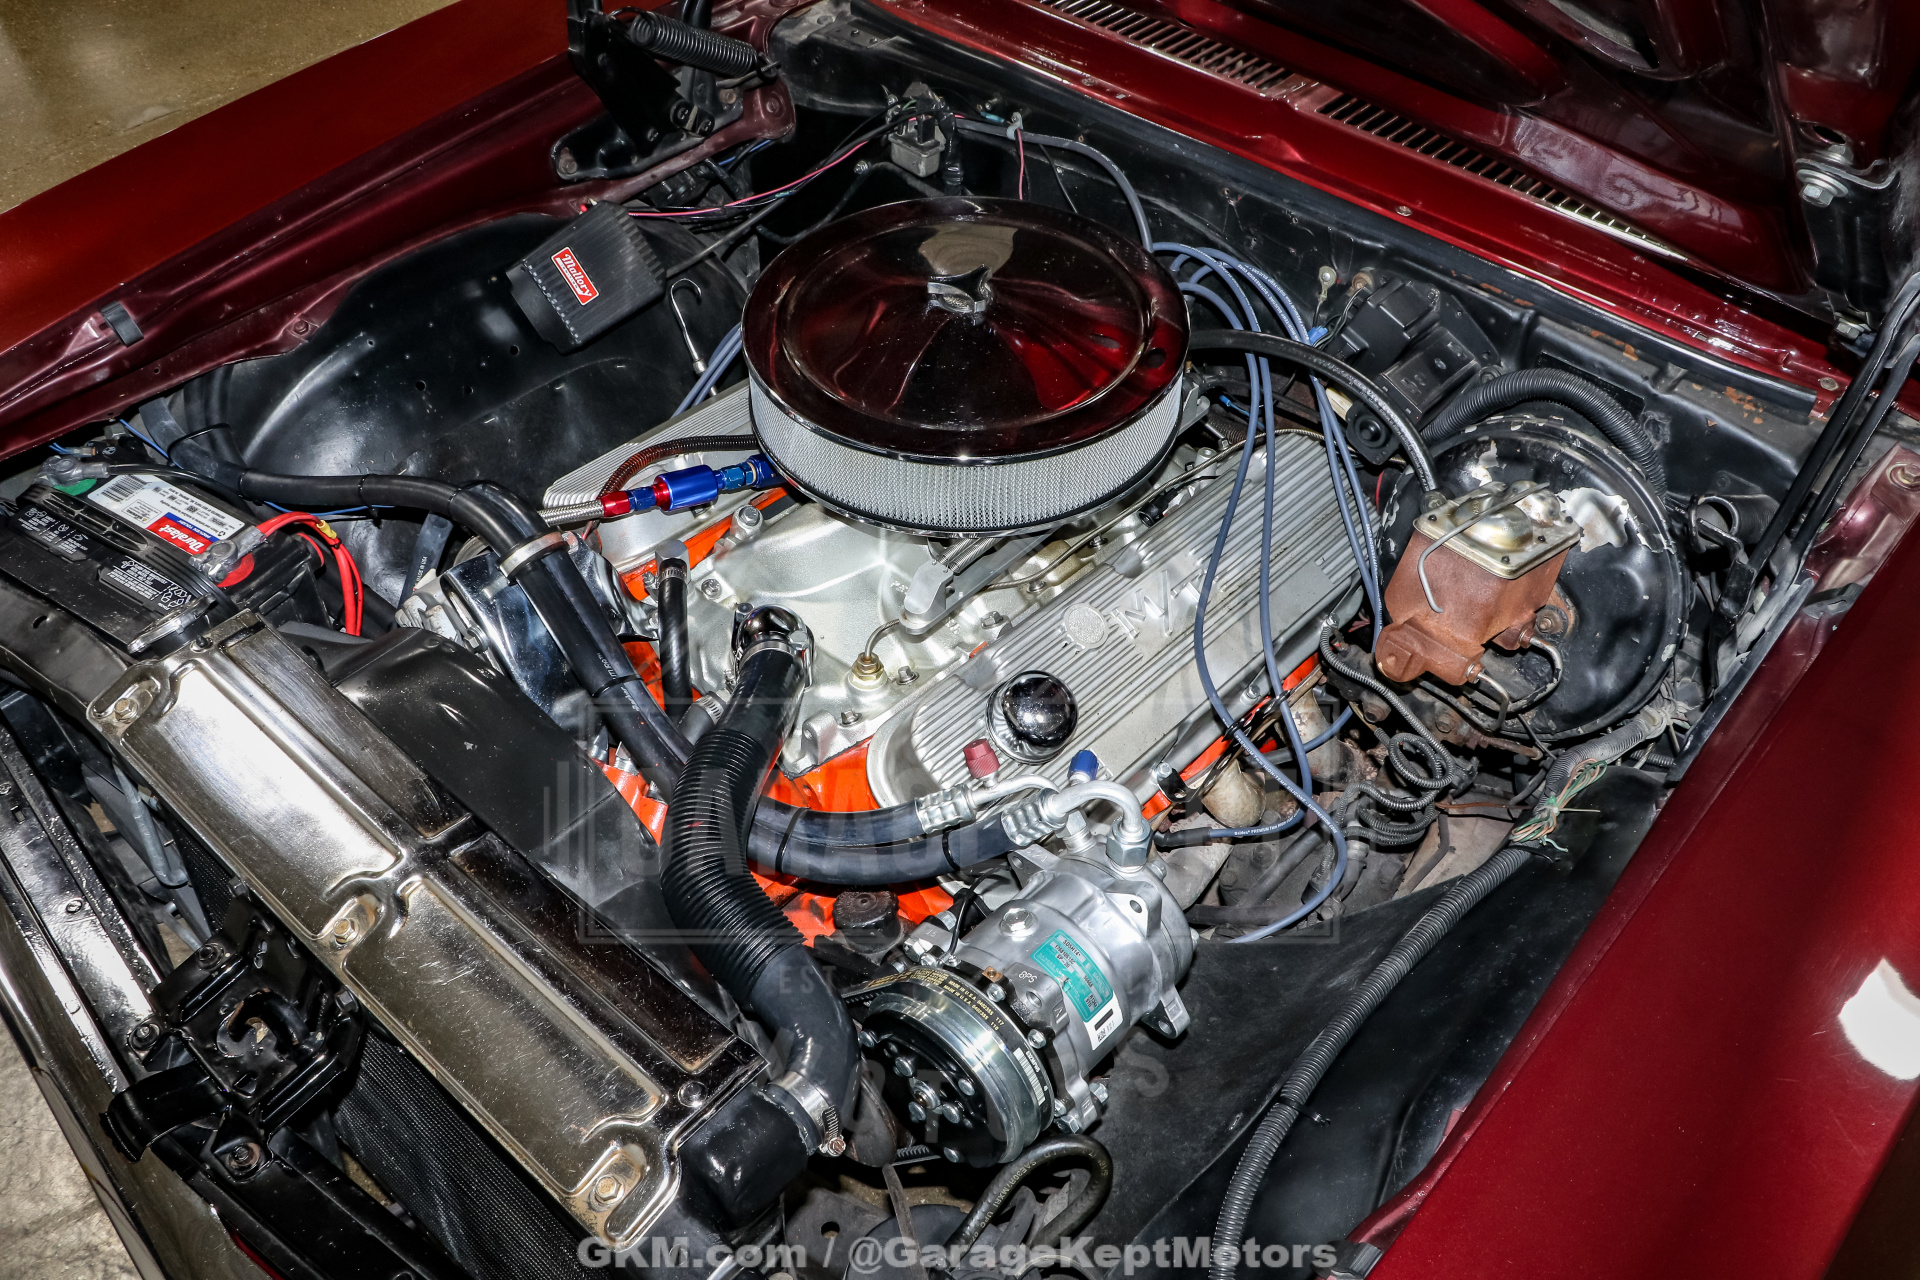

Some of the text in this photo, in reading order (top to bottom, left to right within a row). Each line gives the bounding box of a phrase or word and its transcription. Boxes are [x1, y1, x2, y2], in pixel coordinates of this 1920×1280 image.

[561, 252, 593, 296] Mallory
[157, 521, 205, 553] Duralast
[942, 984, 955, 994] MADE
[948, 979, 960, 989] MADE
